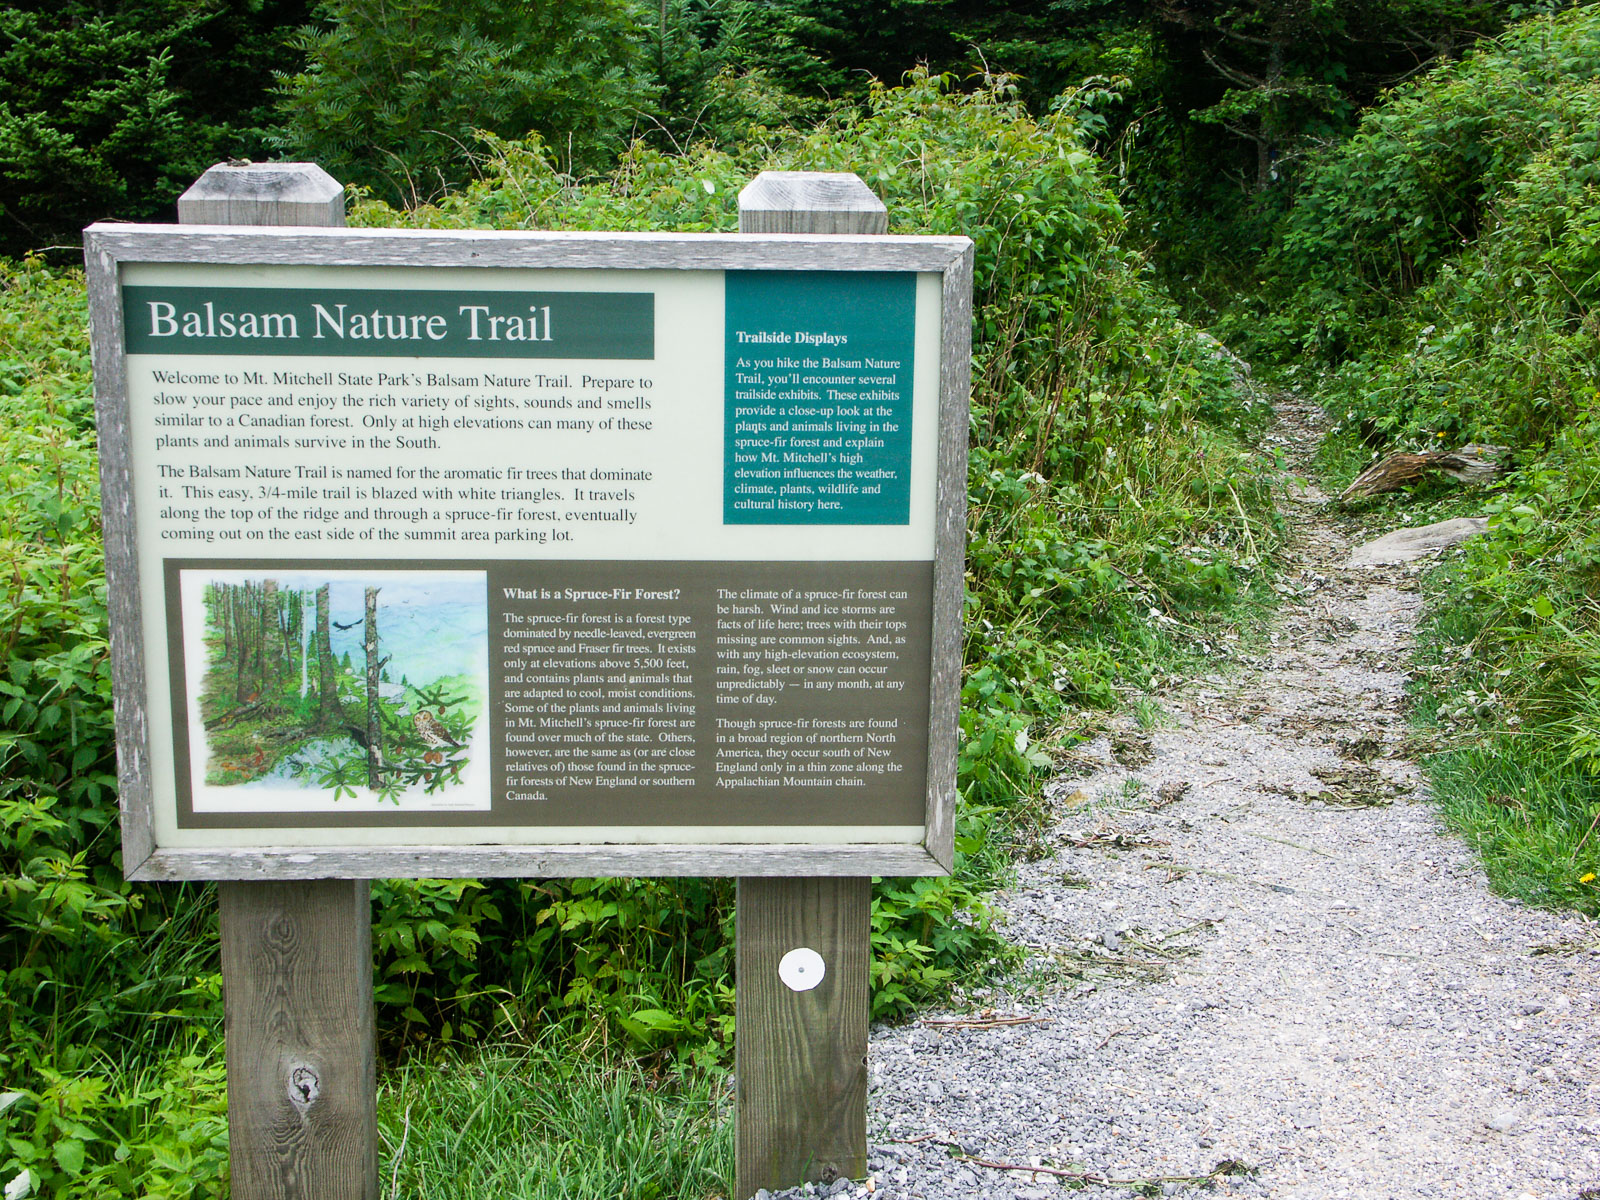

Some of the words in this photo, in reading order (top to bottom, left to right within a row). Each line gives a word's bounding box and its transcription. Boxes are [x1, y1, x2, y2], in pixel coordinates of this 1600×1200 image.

[146, 301, 300, 337] Balsam
[311, 304, 447, 339] Nature
[459, 305, 553, 340] Trail
[735, 331, 791, 343] Trailside
[794, 331, 847, 346] Displays
[735, 357, 751, 367] As
[753, 359, 773, 370] you
[776, 356, 799, 368] hike
[802, 357, 819, 368] the
[821, 357, 861, 368] Balsam
[864, 357, 900, 368] Nature
[151, 370, 219, 384] Welcome
[224, 373, 238, 384] to
[243, 371, 267, 384] Mt.
[273, 372, 332, 385] Mitchell
[338, 372, 372, 385] State
[378, 373, 421, 386] Park's
[427, 373, 478, 386] Balsam
[484, 374, 530, 387] Nature
[534, 374, 572, 387] Trail.
[582, 375, 634, 391] Prepare
[639, 378, 652, 388] to
[735, 372, 764, 384] Trail,
[767, 373, 799, 386] you'll
[802, 375, 856, 384] encounter
[858, 373, 895, 384] several
[153, 391, 187, 405] slow
[192, 396, 226, 409] your
[230, 396, 262, 409] pace
[267, 393, 293, 406] and
[297, 396, 337, 410] enjoy
[342, 393, 364, 406] the
[369, 394, 396, 407] rich
[401, 396, 449, 411] variety
[454, 394, 470, 407] of
[474, 395, 519, 411] sights,
[523, 395, 572, 408] sounds
[577, 396, 602, 408] and
[607, 396, 651, 409] smells
[735, 388, 776, 399] trailside
[777, 389, 821, 400] exhibits.
[826, 389, 857, 400] These
[859, 389, 899, 400] exhibits
[735, 404, 776, 418] provide
[779, 407, 785, 415] a
[788, 405, 834, 418] close-up
[836, 405, 860, 416] look
[863, 407, 873, 416] at
[876, 405, 892, 416] the
[154, 413, 204, 426] similar
[208, 416, 222, 426] to
[226, 417, 234, 426] a
[238, 413, 305, 427] Canadian
[310, 415, 353, 427] forest.
[362, 414, 396, 431] Only
[401, 417, 414, 427] at
[418, 415, 449, 431] high
[453, 415, 523, 428] elevations
[527, 419, 551, 429] can
[556, 420, 594, 433] many
[598, 417, 611, 429] of
[617, 417, 652, 430] these
[155, 434, 198, 451] plants
[203, 434, 229, 447] and
[234, 434, 289, 448] animals
[294, 438, 346, 448] survive
[351, 436, 364, 448] in
[369, 435, 390, 448] the
[396, 435, 440, 448] South.
[734, 451, 758, 462] how
[761, 451, 779, 462] Mt.
[783, 451, 836, 463] Mitchell's
[839, 452, 863, 465] high
[160, 530, 214, 543] coming
[219, 529, 241, 539] out
[246, 530, 263, 539] on
[268, 527, 289, 539] the
[294, 529, 321, 540] east
[326, 527, 354, 540] side
[359, 528, 372, 540] of
[378, 527, 399, 540] the
[404, 530, 455, 540] summit
[460, 531, 489, 540] area
[494, 528, 546, 544] parking
[552, 528, 573, 541] lot.
[502, 587, 537, 599] What
[540, 587, 550, 599] is
[553, 591, 561, 599] a
[564, 588, 632, 602] Spruce-Fir
[634, 588, 680, 599] Forest?
[716, 588, 737, 599] The
[739, 588, 778, 599] climate
[781, 588, 793, 599] of
[795, 591, 801, 599] a
[804, 588, 855, 602] spruce-fir
[857, 588, 886, 599] forest
[889, 591, 907, 599] can
[716, 603, 729, 614] be
[732, 603, 763, 614] harsh.
[770, 603, 798, 614] Wind
[801, 603, 820, 614] and
[823, 603, 839, 614] ice
[841, 605, 876, 614] storms
[879, 606, 895, 614] are
[502, 612, 524, 623] The
[526, 612, 578, 626] spruce-fir
[581, 612, 611, 623] forest
[614, 612, 623, 623] is
[626, 615, 632, 623] a
[635, 612, 665, 623] forest
[668, 614, 691, 626] type
[717, 618, 741, 629] facts
[743, 618, 756, 629] of
[757, 618, 775, 629] life
[777, 619, 803, 630] here;
[806, 620, 830, 629] trees
[833, 618, 856, 629] with
[859, 618, 883, 629] their
[885, 620, 906, 631] tops
[716, 633, 757, 646] missing
[759, 636, 776, 644] are
[778, 636, 824, 644] common
[827, 633, 860, 646] sights.
[866, 633, 892, 645] And,
[894, 636, 906, 644] as
[503, 642, 520, 653] red
[522, 645, 555, 655] spruce
[557, 643, 576, 653] and
[578, 642, 610, 653] Fraser
[612, 642, 624, 653] fir
[625, 644, 652, 653] trees.
[657, 643, 665, 653] It
[667, 643, 696, 653] exists
[503, 657, 527, 670] only
[530, 659, 540, 668] at
[542, 658, 596, 668] elevations
[599, 658, 630, 668] above
[633, 658, 663, 669] 5,500
[666, 658, 689, 669] feet,
[523, 687, 563, 700] adapted
[566, 689, 576, 697] to
[578, 687, 605, 698] cool,
[607, 687, 636, 698] moist
[638, 687, 695, 698] conditions.
[715, 776, 780, 789] Appalachian
[783, 776, 832, 786] Mountain
[835, 776, 865, 786] chain.
